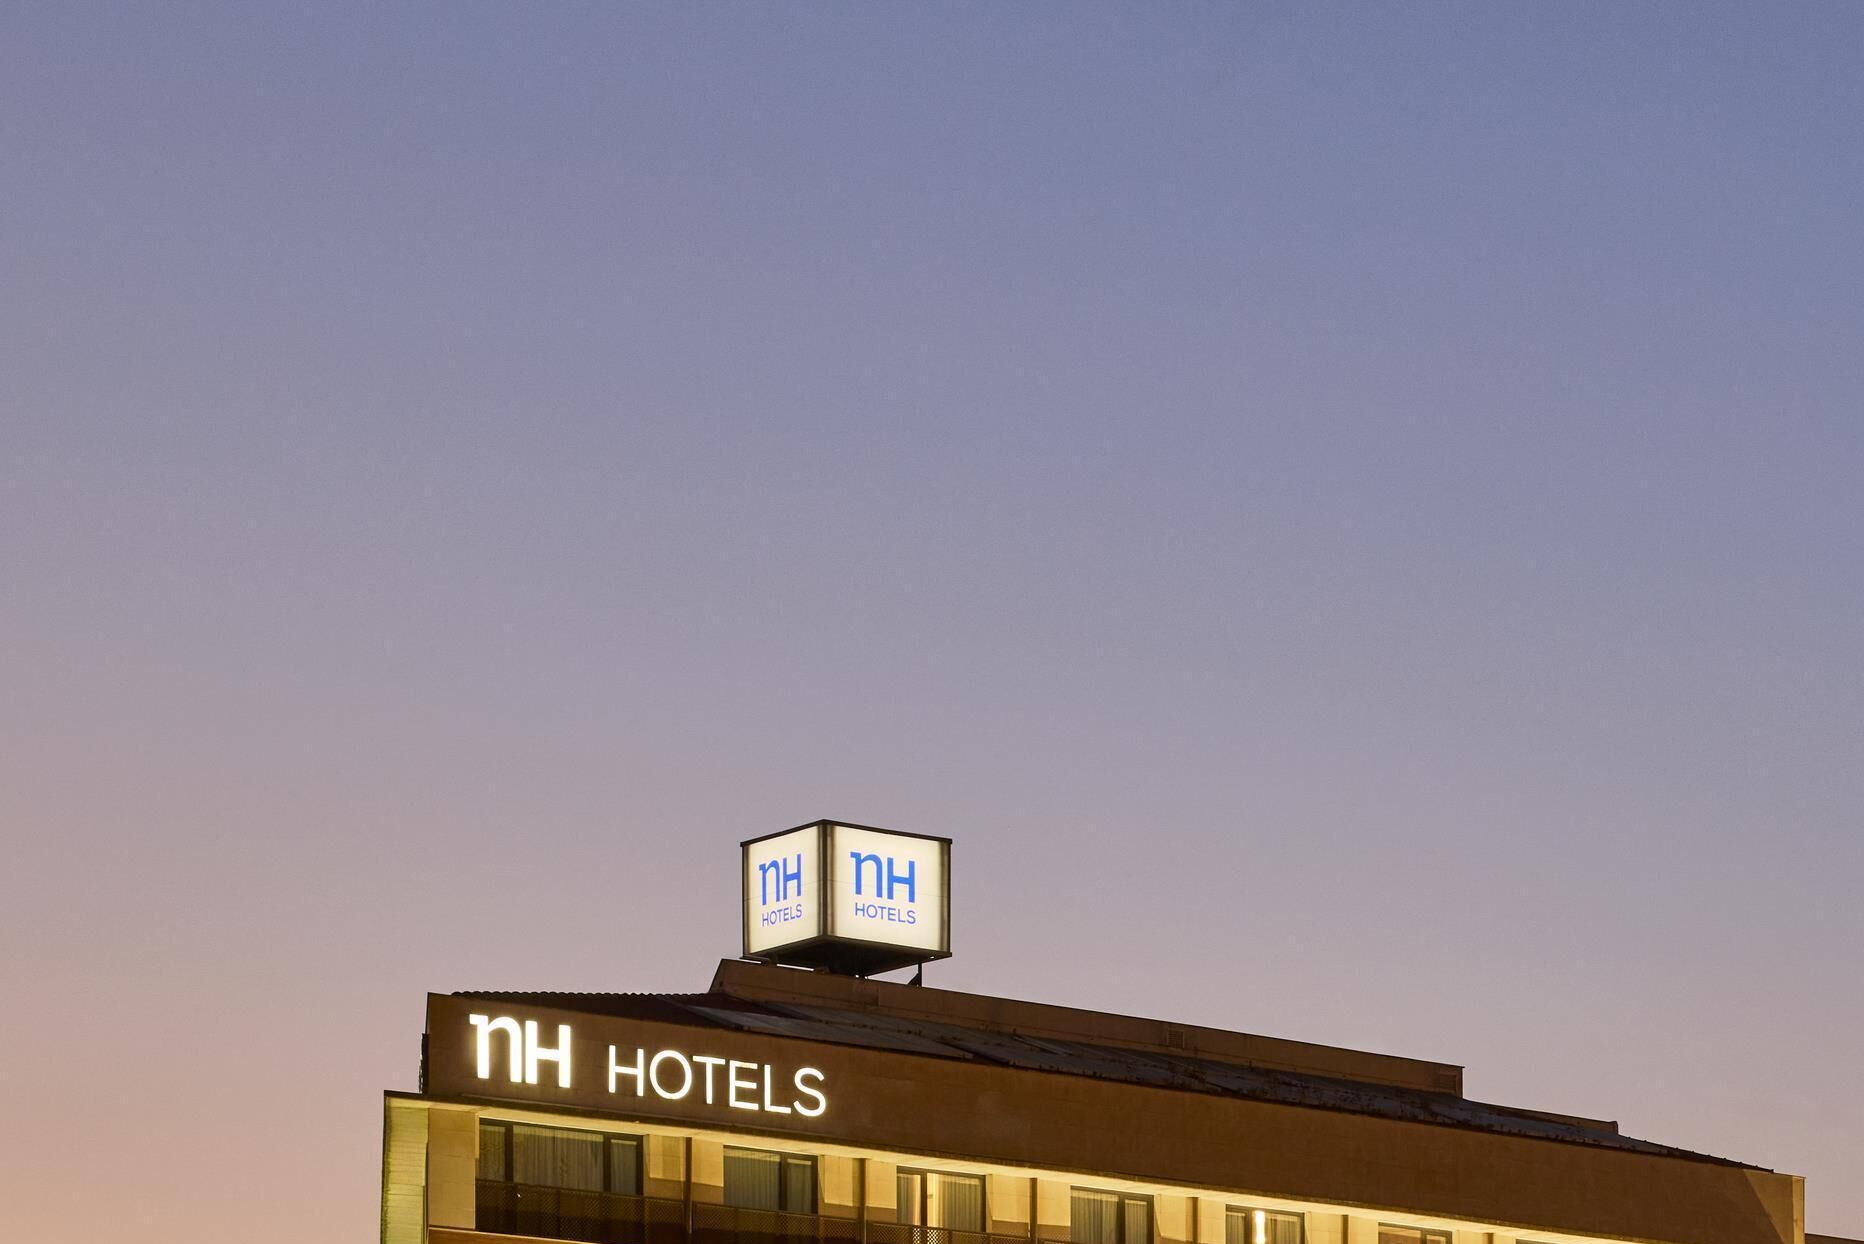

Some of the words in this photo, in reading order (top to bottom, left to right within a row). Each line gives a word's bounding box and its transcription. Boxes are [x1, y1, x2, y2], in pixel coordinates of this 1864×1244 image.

[762, 903, 803, 927] HOTELS
[855, 902, 916, 925] HOTELS
[607, 1044, 827, 1118] HOTELS
